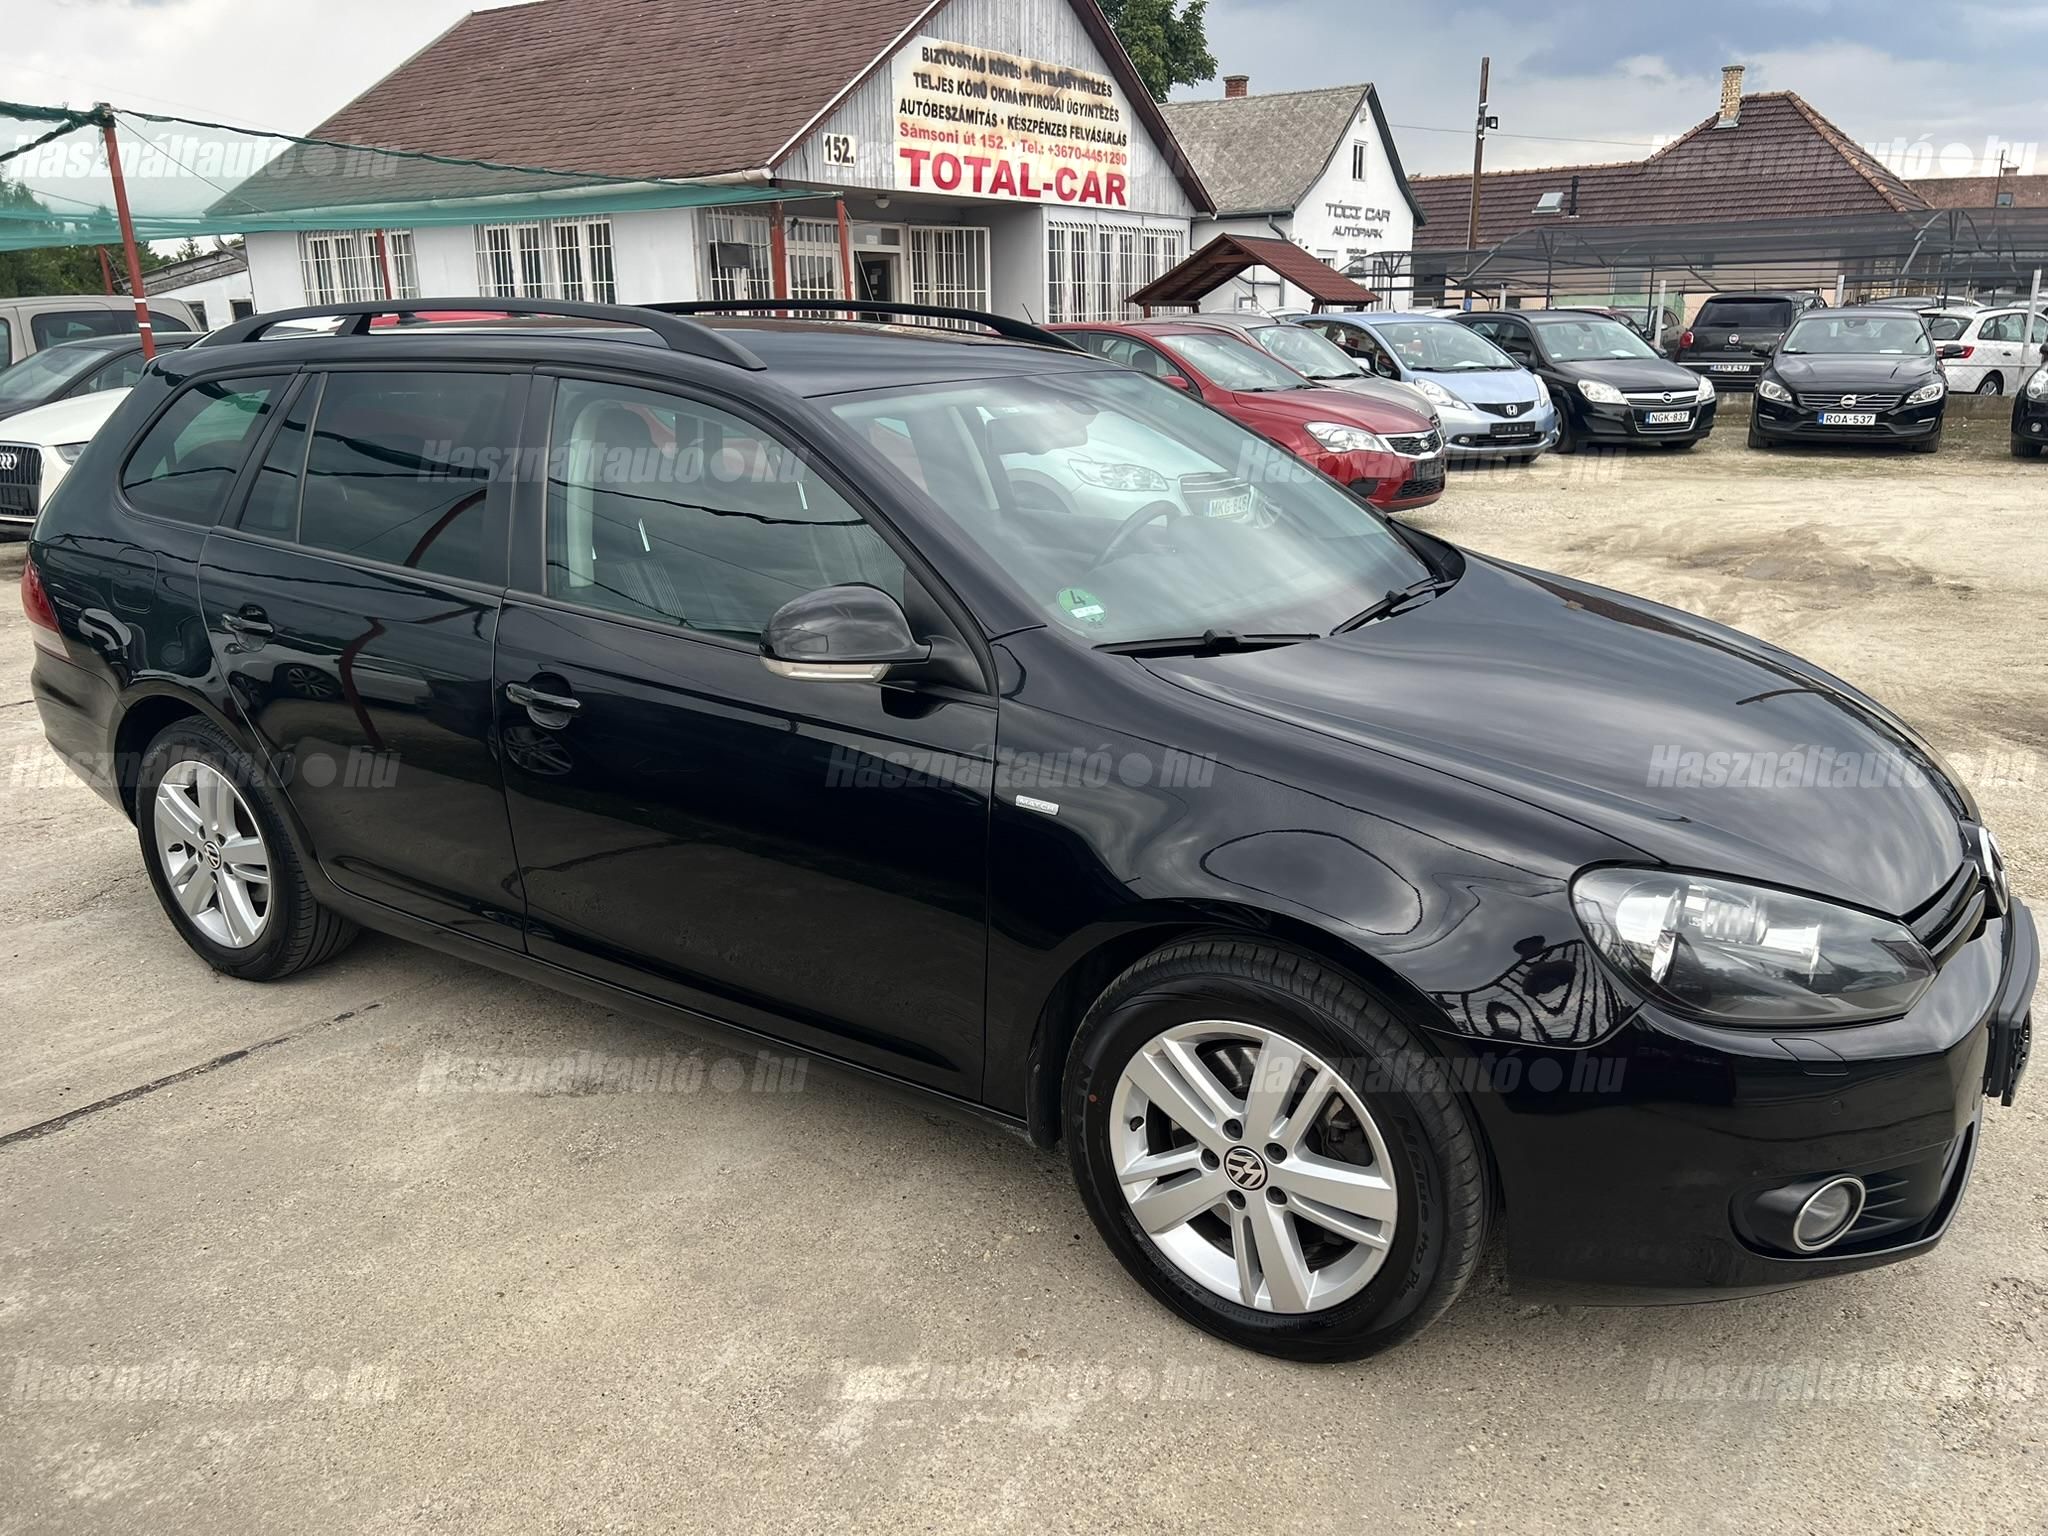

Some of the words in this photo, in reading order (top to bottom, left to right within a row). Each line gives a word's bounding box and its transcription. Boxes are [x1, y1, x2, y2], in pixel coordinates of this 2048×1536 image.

[913, 72, 954, 94] TELJES
[991, 85, 1064, 113] OKMÁNYIRODAI
[899, 97, 998, 127] AUTÓBESZÁMÍTÁS
[1007, 114, 1067, 138] KÉSZPÉNZES
[1070, 125, 1127, 147] FELVÁSÁRLÁS
[900, 122, 959, 145] Sámsoni
[963, 132, 976, 146] út
[980, 134, 1007, 150] 152.
[825, 135, 854, 164] 152.
[900, 147, 1127, 206] TOTAL-CAR
[1825, 414, 1873, 424] ROA-537
